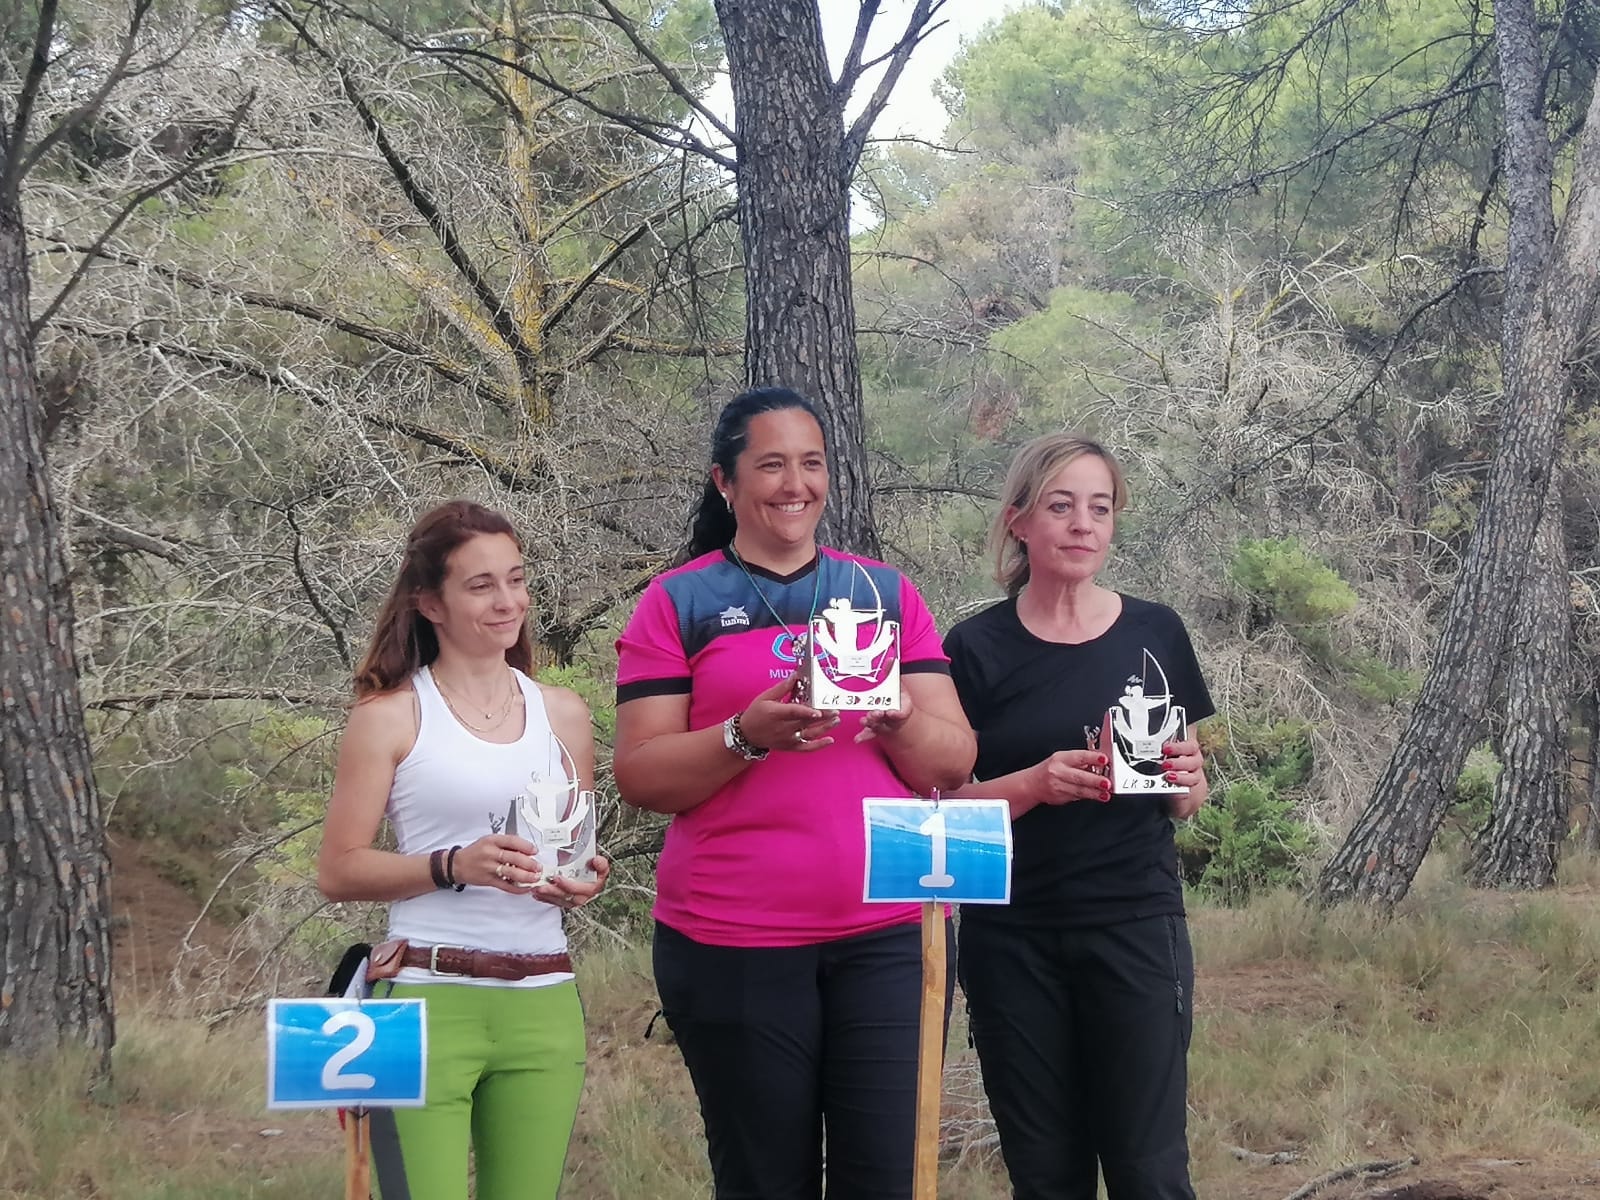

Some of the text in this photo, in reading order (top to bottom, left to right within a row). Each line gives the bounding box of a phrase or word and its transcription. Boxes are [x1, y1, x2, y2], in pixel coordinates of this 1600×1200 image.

[769, 668, 796, 679] MUT
[919, 813, 955, 888] 1
[321, 1010, 377, 1091] 2
